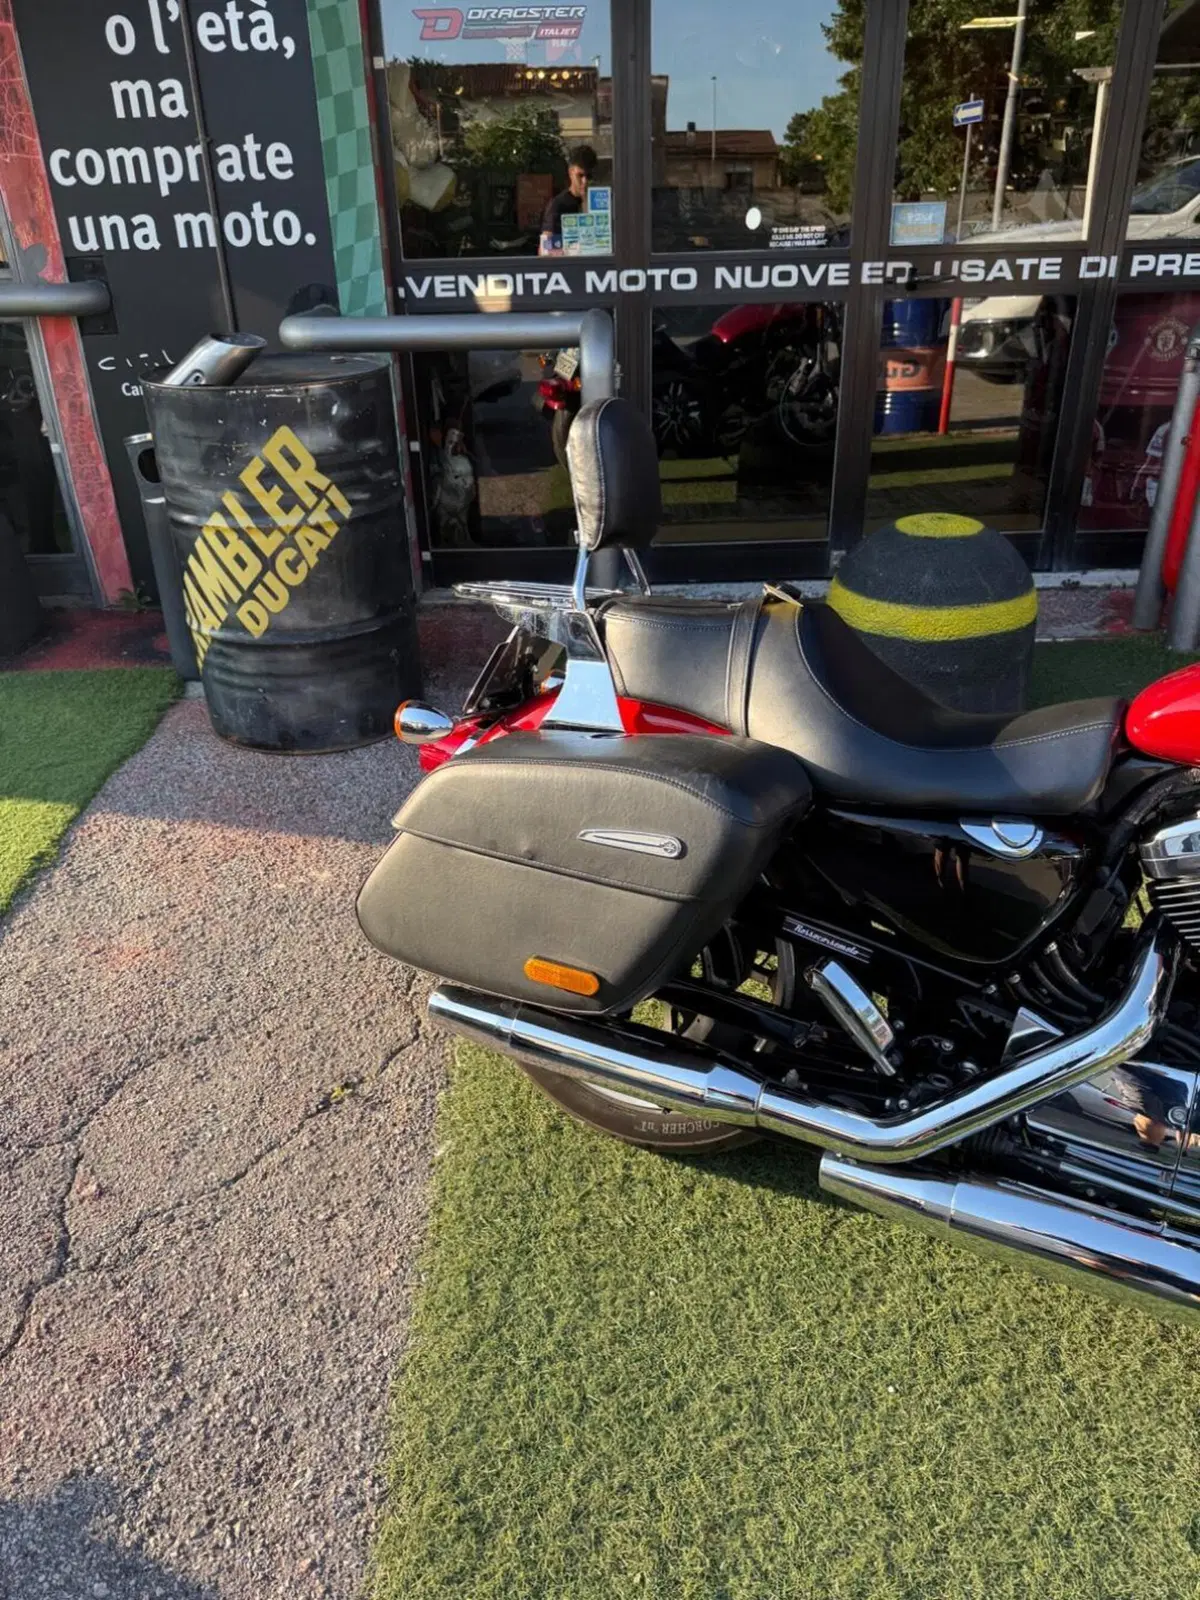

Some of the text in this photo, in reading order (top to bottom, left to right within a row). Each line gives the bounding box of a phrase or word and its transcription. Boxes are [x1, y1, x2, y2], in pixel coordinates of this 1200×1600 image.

[105, 12, 136, 56] o
[467, 6, 587, 20] DRAGSTER
[110, 77, 190, 119] ma
[49, 133, 294, 197] comprate
[68, 201, 317, 253] una moto.
[405, 272, 571, 298] VENDITA
[585, 267, 698, 293] MOTO
[714, 263, 850, 290] NUOVE
[1079, 256, 1118, 278] DI
[236, 485, 353, 640] DUCATI
